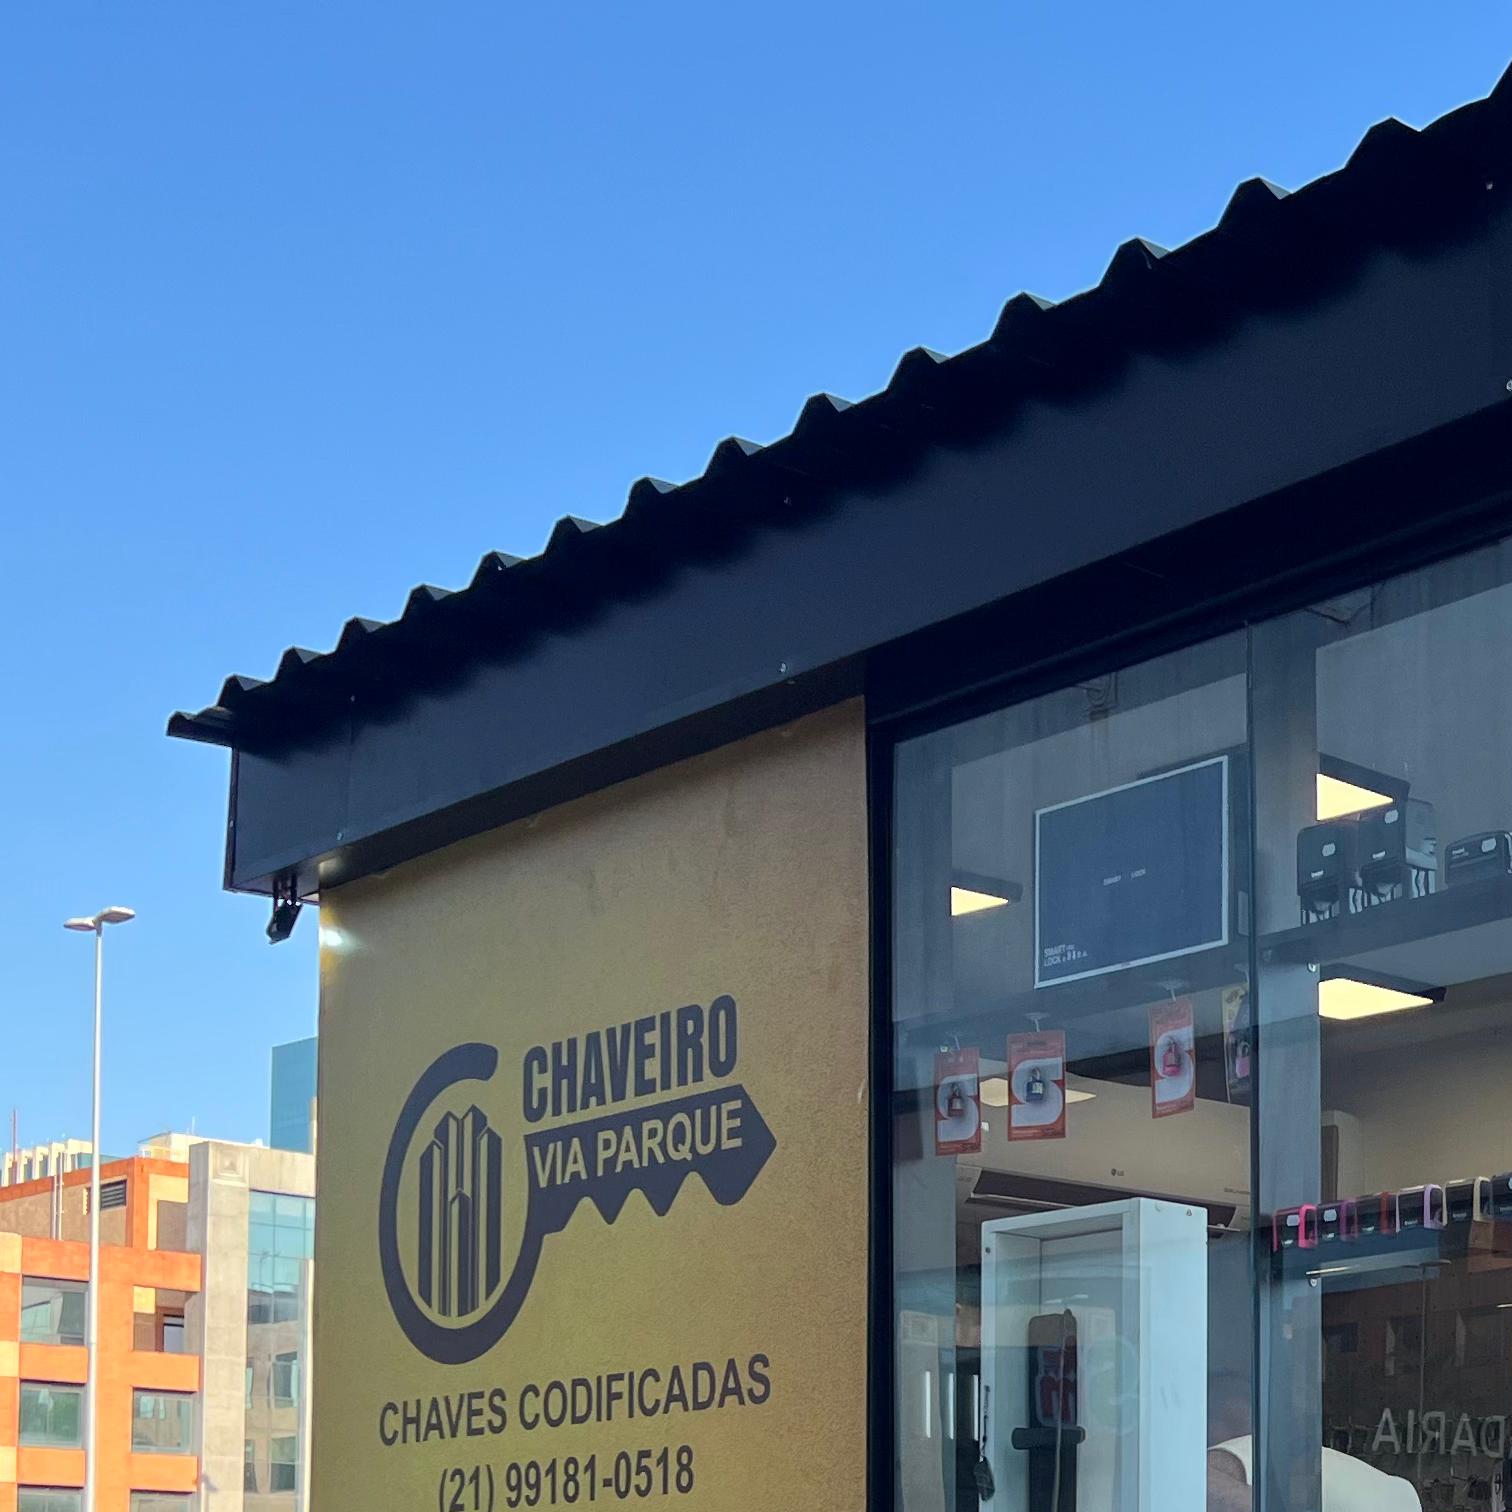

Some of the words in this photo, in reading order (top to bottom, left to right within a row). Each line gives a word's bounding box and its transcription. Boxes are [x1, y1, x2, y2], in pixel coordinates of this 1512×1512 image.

[523, 994, 737, 1123] CHAVEIRO
[533, 1138, 587, 1189] VIA
[597, 1100, 744, 1177] PARQUE
[380, 1388, 507, 1446] CHAVES
[519, 1354, 771, 1430] CODIFICADAS
[506, 1445, 694, 1509] 99181-0518
